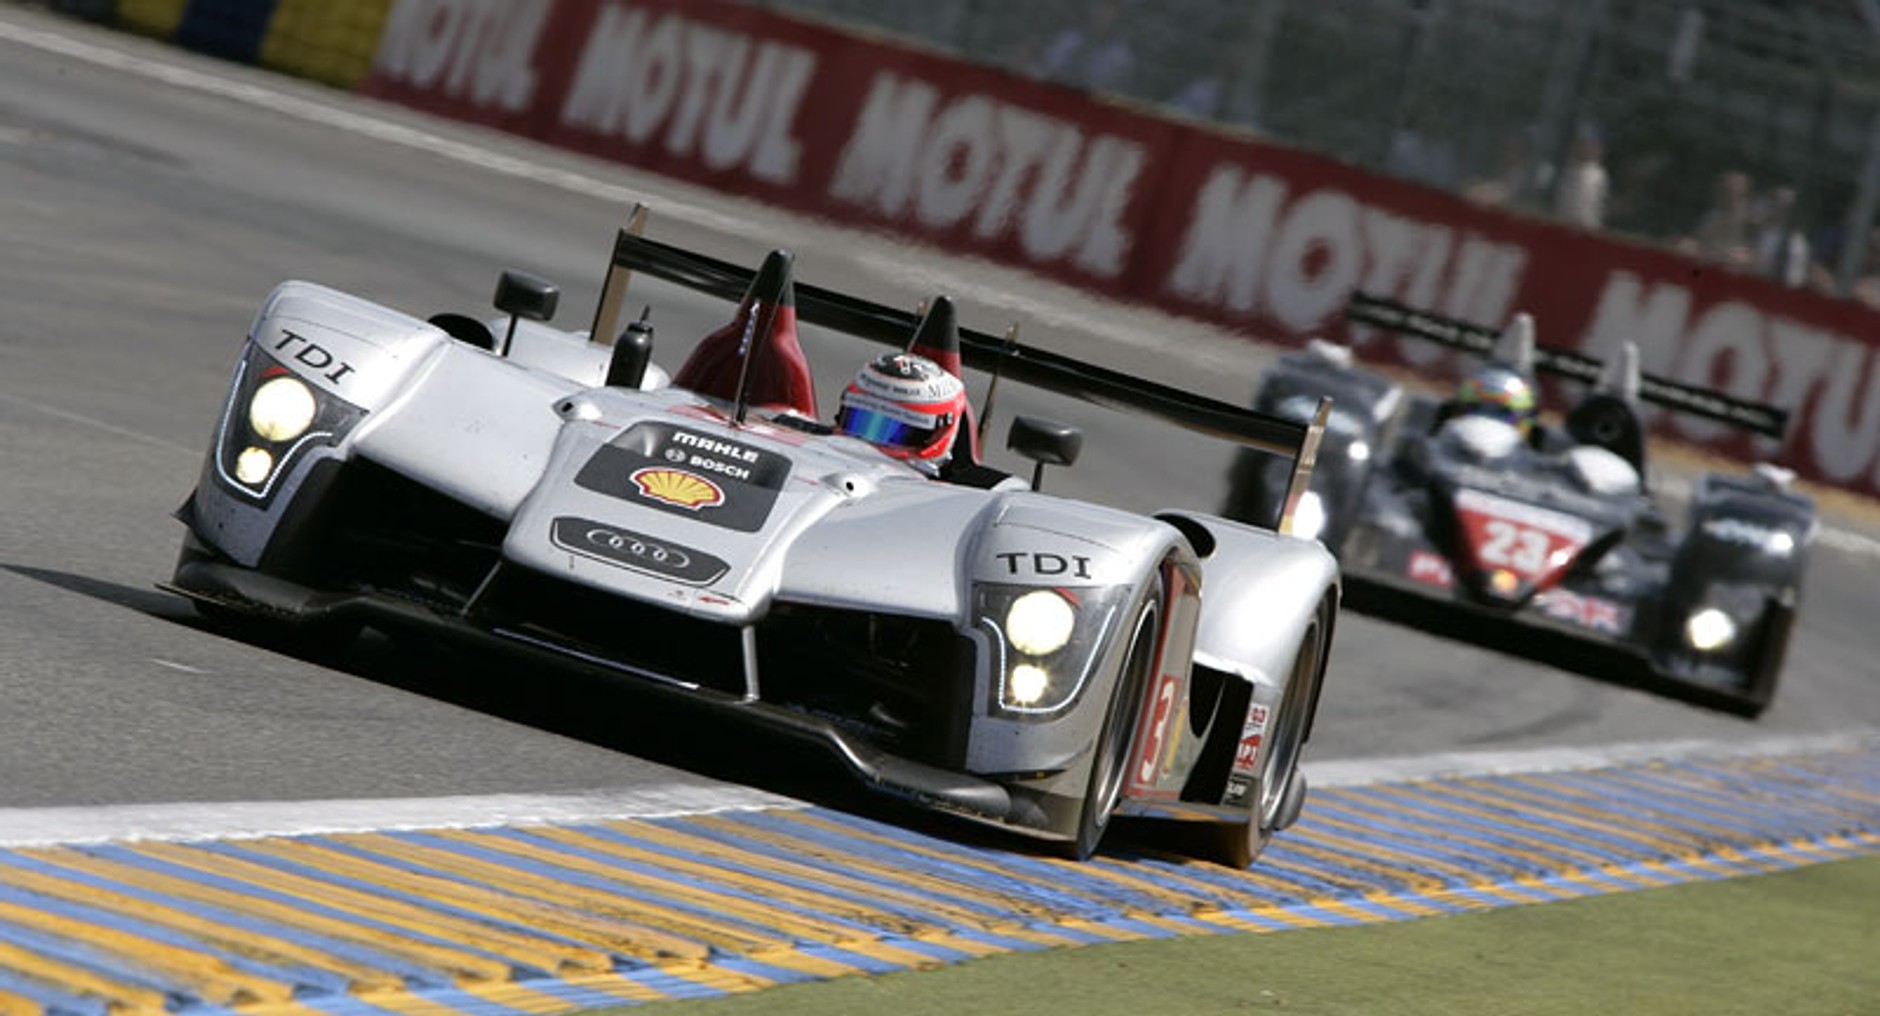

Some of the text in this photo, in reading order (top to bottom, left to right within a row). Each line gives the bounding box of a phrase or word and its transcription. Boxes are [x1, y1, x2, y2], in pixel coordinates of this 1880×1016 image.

[372, 0, 552, 112] OTUL
[560, 2, 817, 184] MOTUL
[830, 72, 1144, 278] MOTUL
[275, 328, 356, 385] TDI
[1566, 270, 1880, 482] MOTU
[673, 431, 759, 463] MAHLE
[690, 455, 750, 480] BOSCH
[996, 552, 1092, 580] TDI
[1477, 519, 1551, 575] 23
